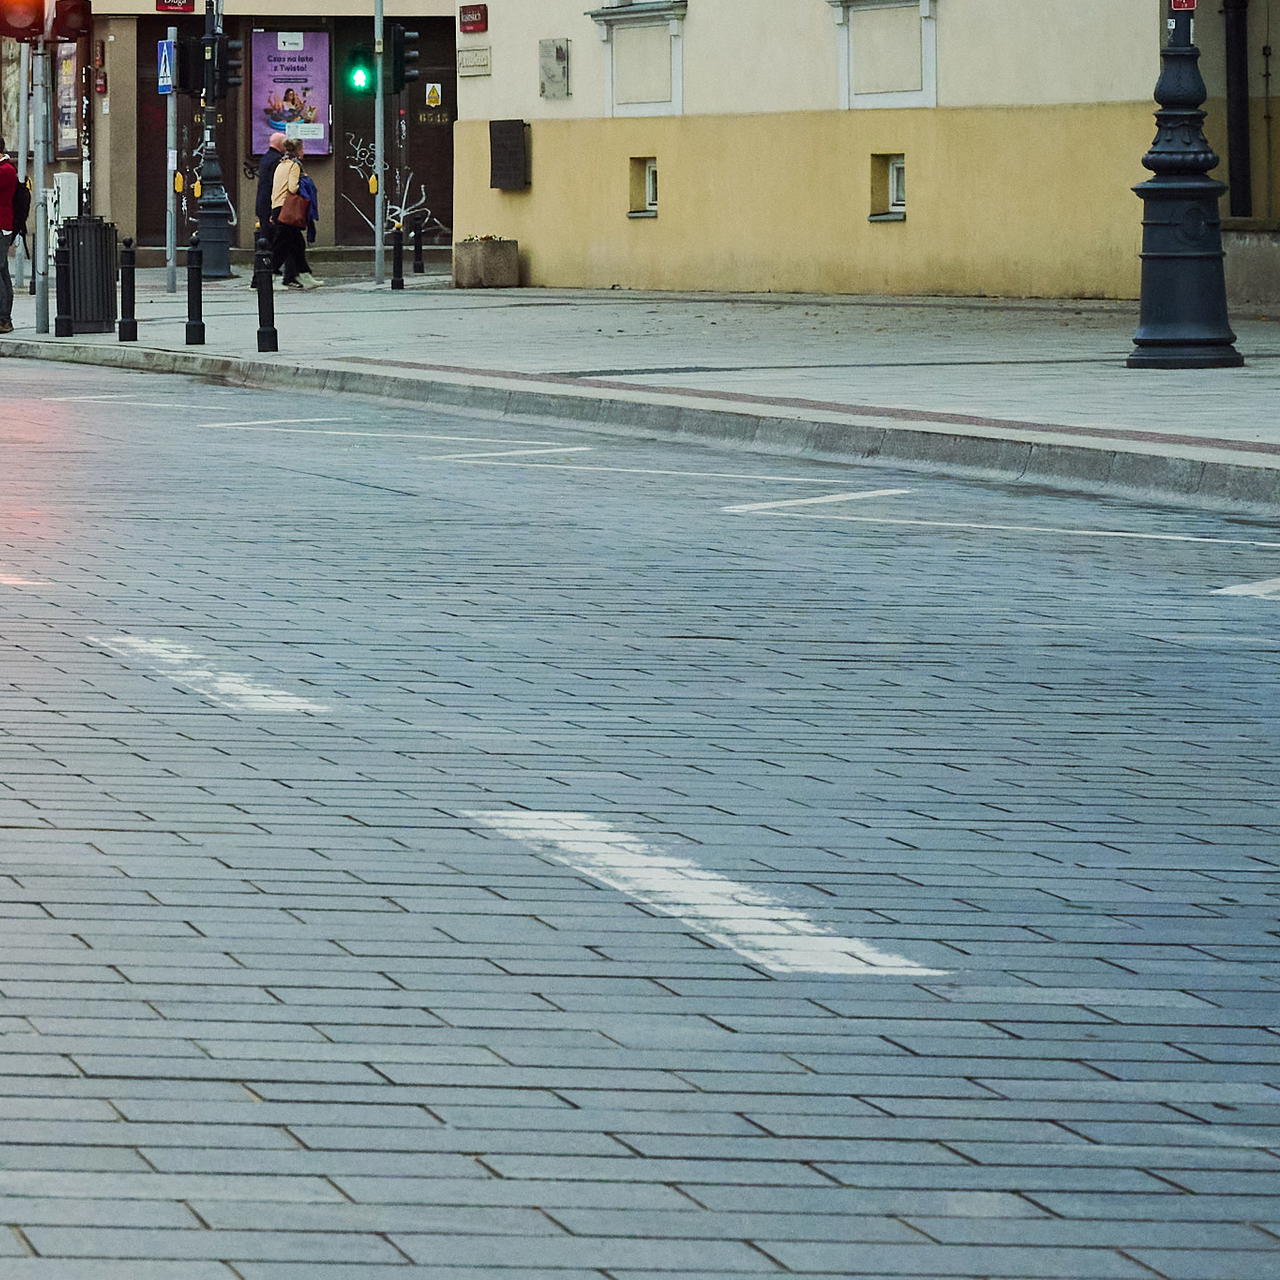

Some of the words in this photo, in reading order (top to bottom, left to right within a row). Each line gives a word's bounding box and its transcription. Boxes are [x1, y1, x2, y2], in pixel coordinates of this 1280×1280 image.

[267, 55, 286, 63] Czas
[279, 64, 307, 72] Twisto!
[194, 114, 224, 122] 65
